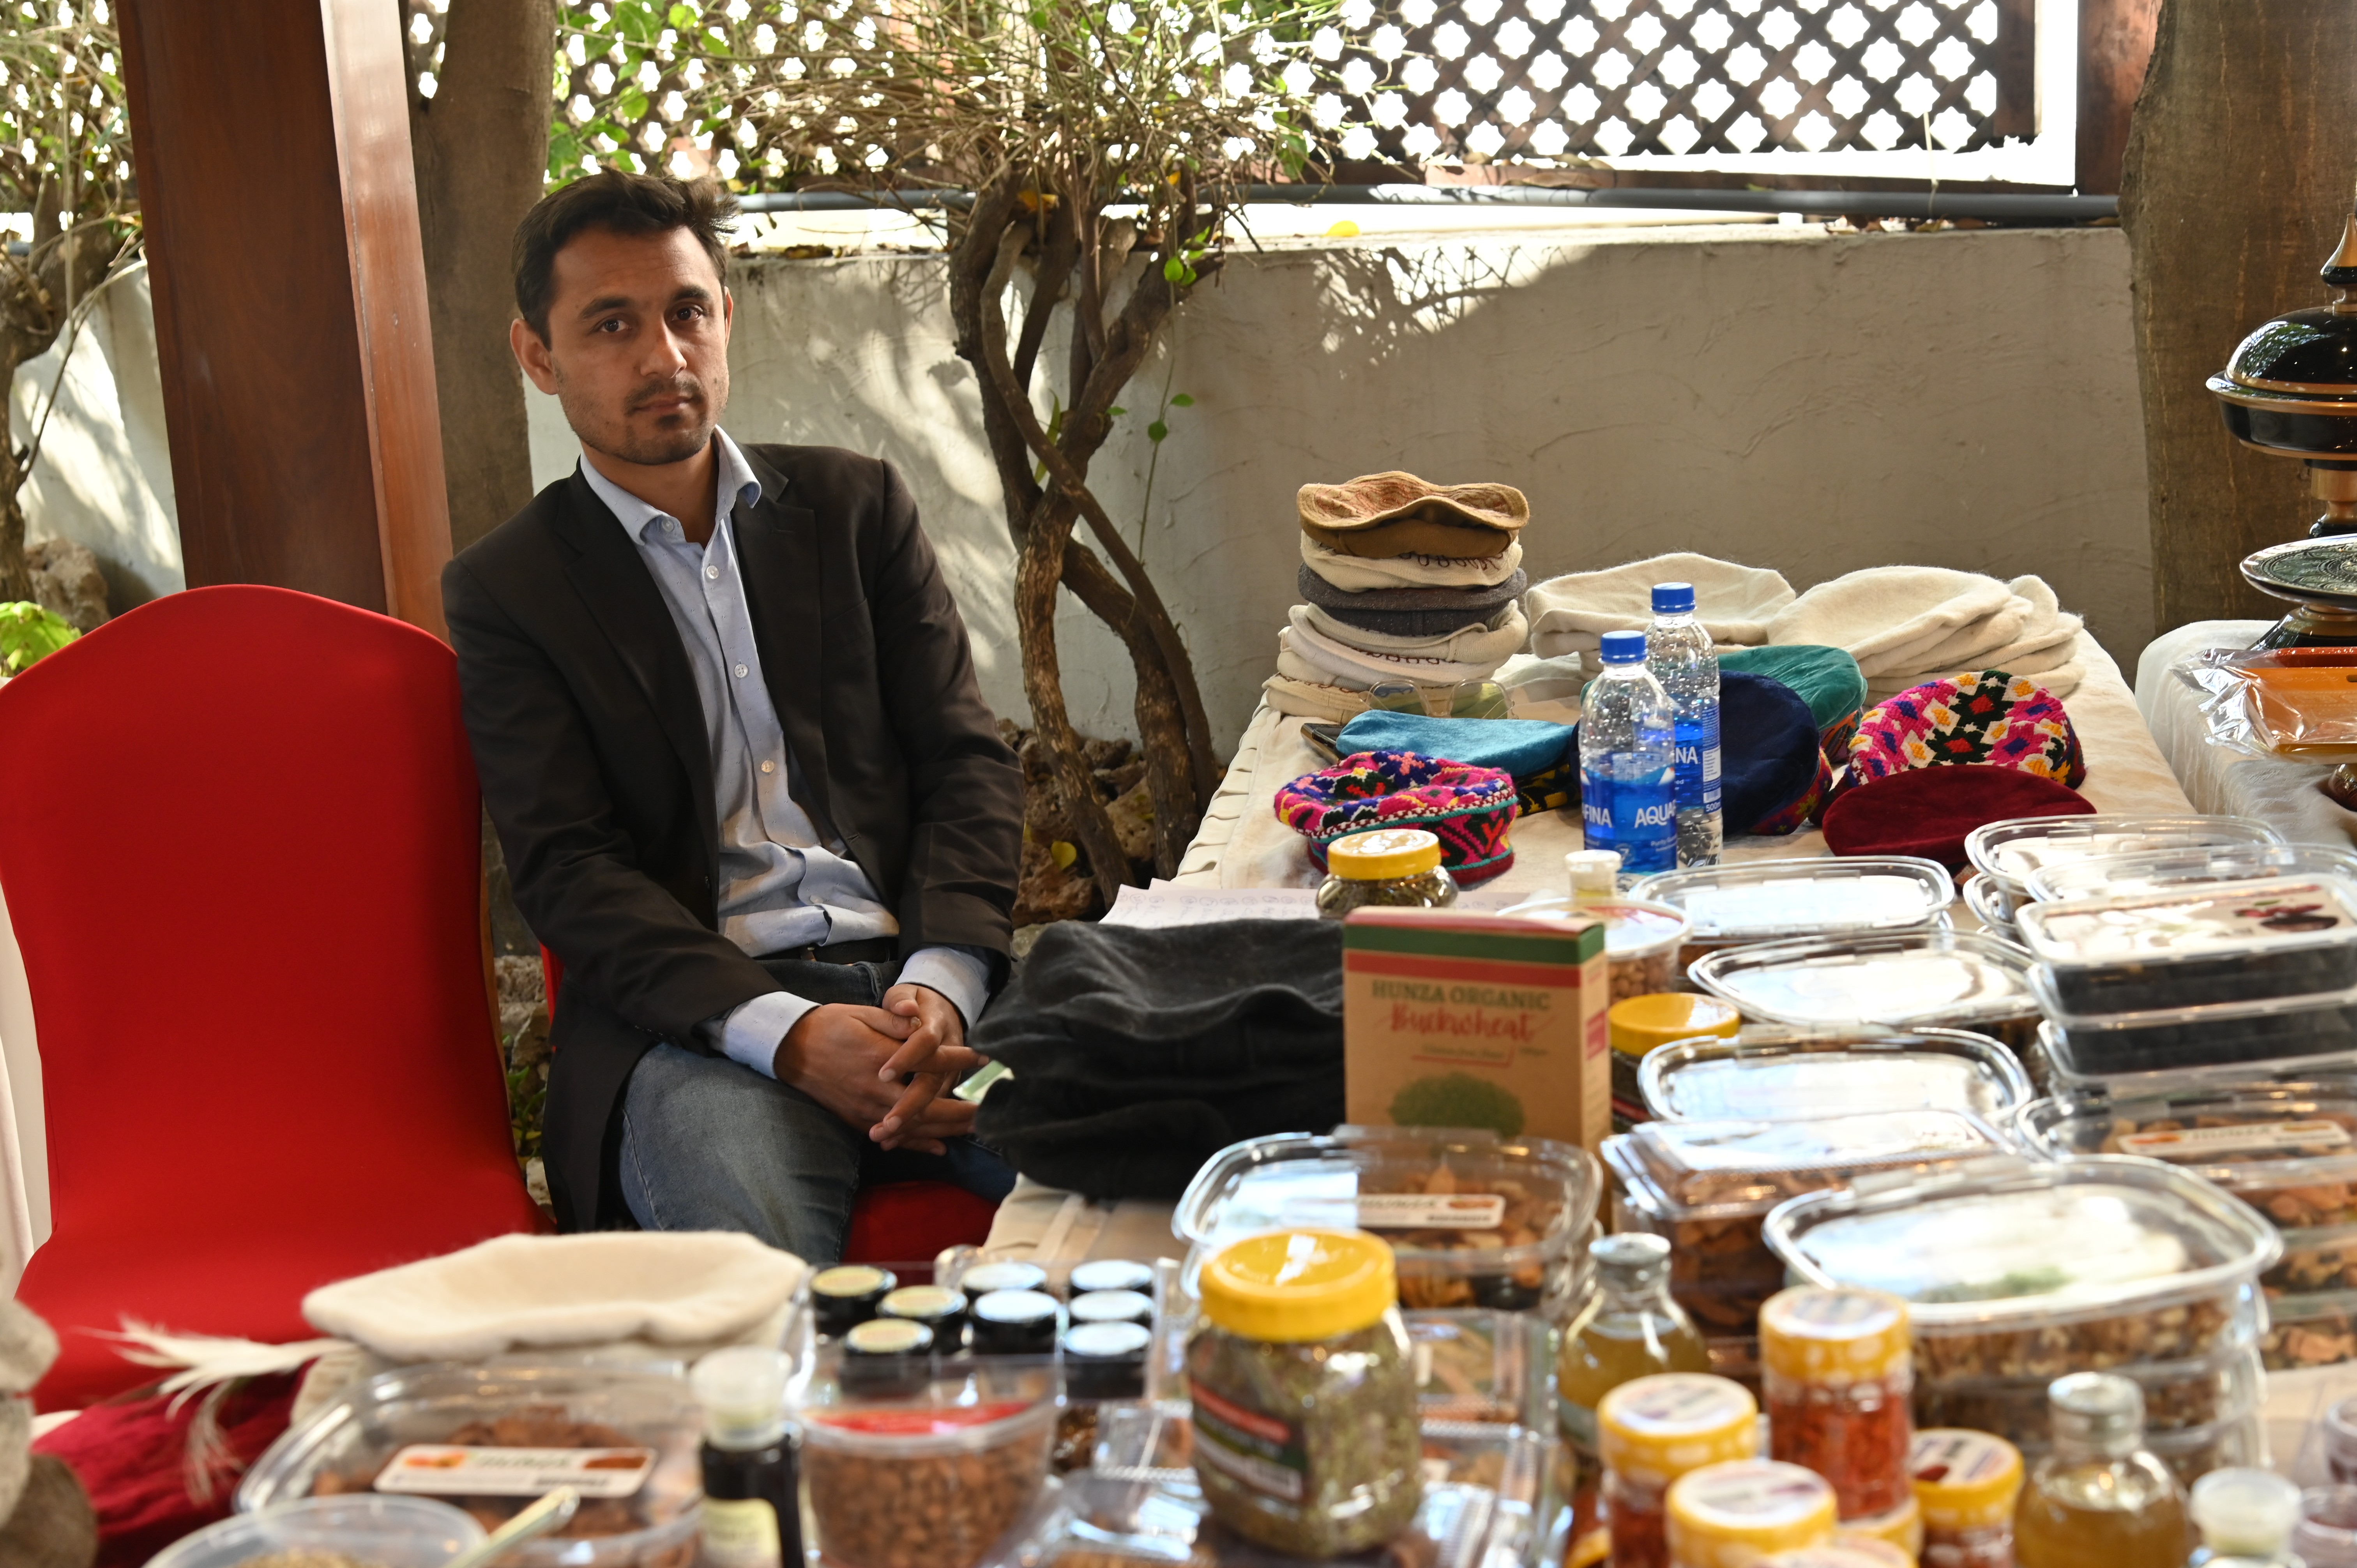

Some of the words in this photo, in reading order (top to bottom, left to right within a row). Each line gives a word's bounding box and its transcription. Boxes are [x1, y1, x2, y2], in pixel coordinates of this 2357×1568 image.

[1582, 802, 1613, 828] FINA
[1371, 979, 1446, 1004] HUNZA
[1449, 985, 1551, 1012] ORGANIC
